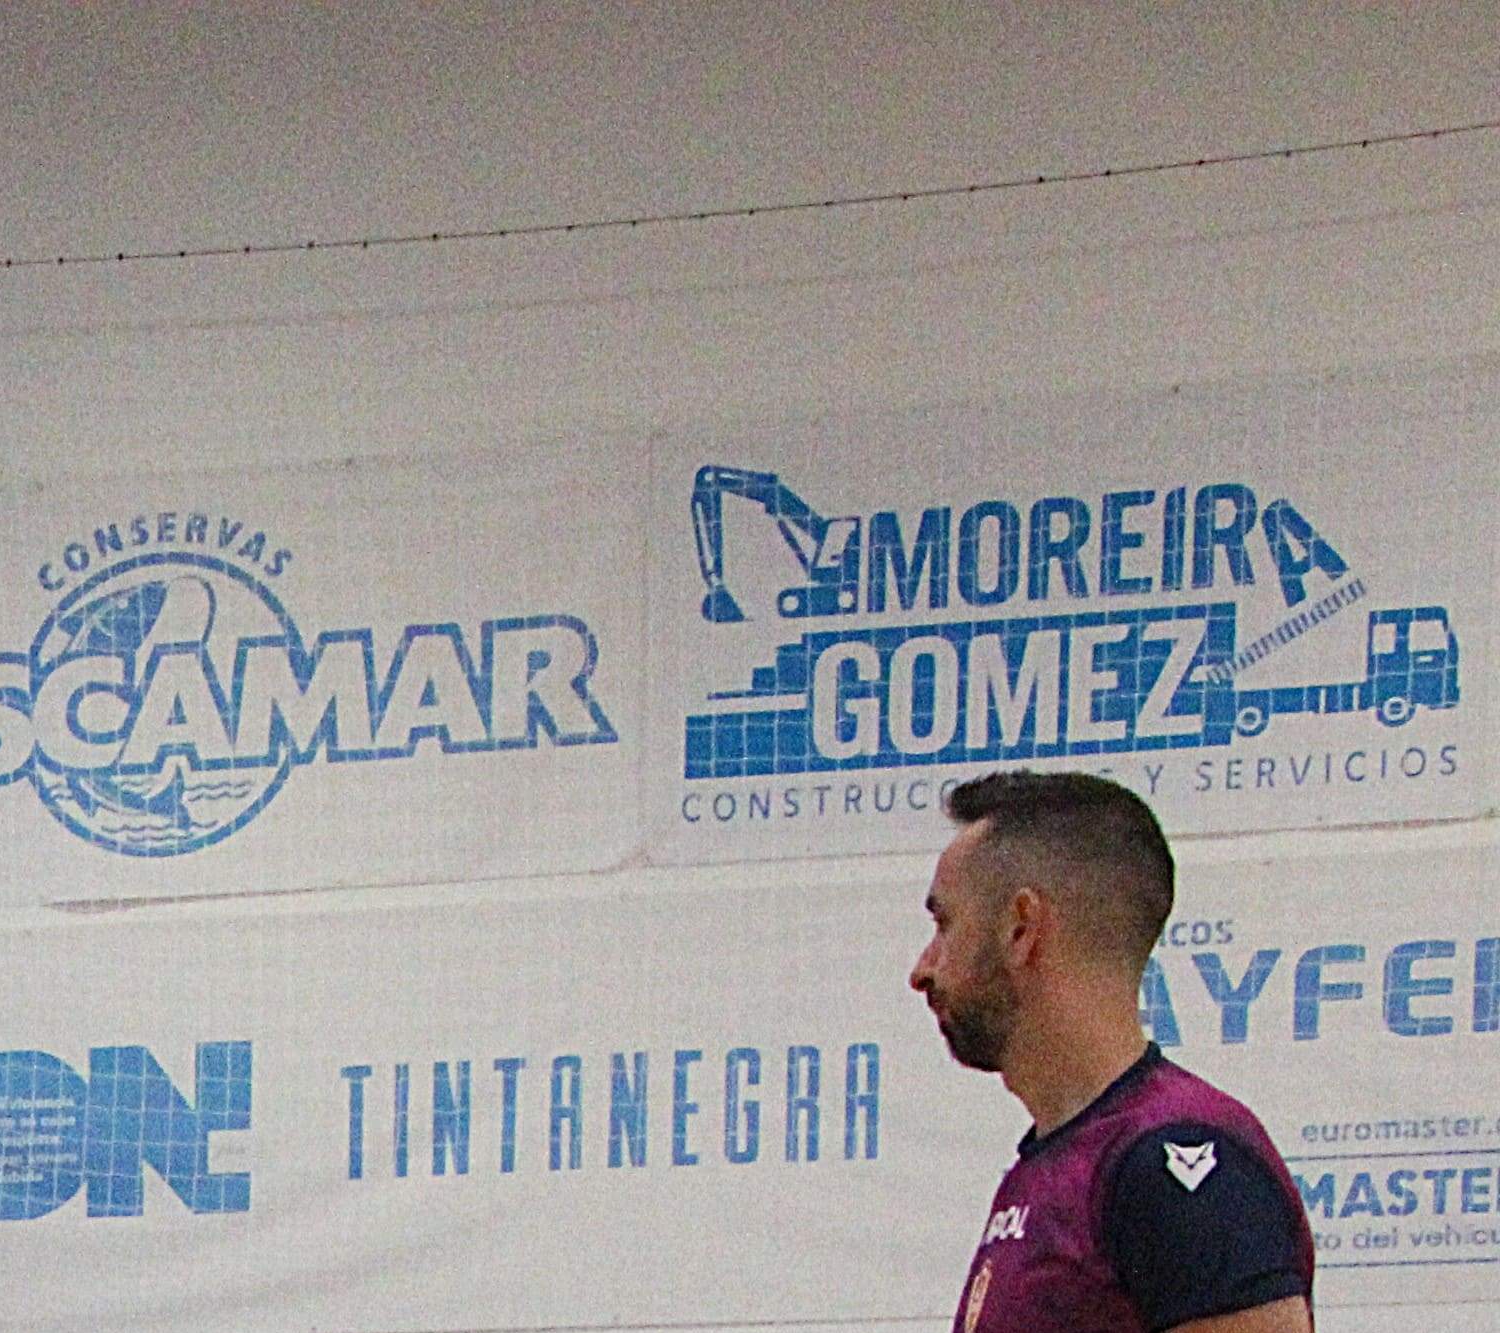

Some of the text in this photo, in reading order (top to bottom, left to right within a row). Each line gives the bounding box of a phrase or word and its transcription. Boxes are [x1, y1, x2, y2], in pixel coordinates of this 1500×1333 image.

[37, 511, 296, 594] CONSERVAS
[866, 483, 1350, 613] MOREIRA
[812, 620, 1208, 761] GOMEZ
[1144, 763, 1164, 795] Y
[1194, 745, 1461, 792] SERVICIOS
[340, 1042, 880, 1180] TINTANEGRA
[1294, 1167, 1500, 1219] MASTE
